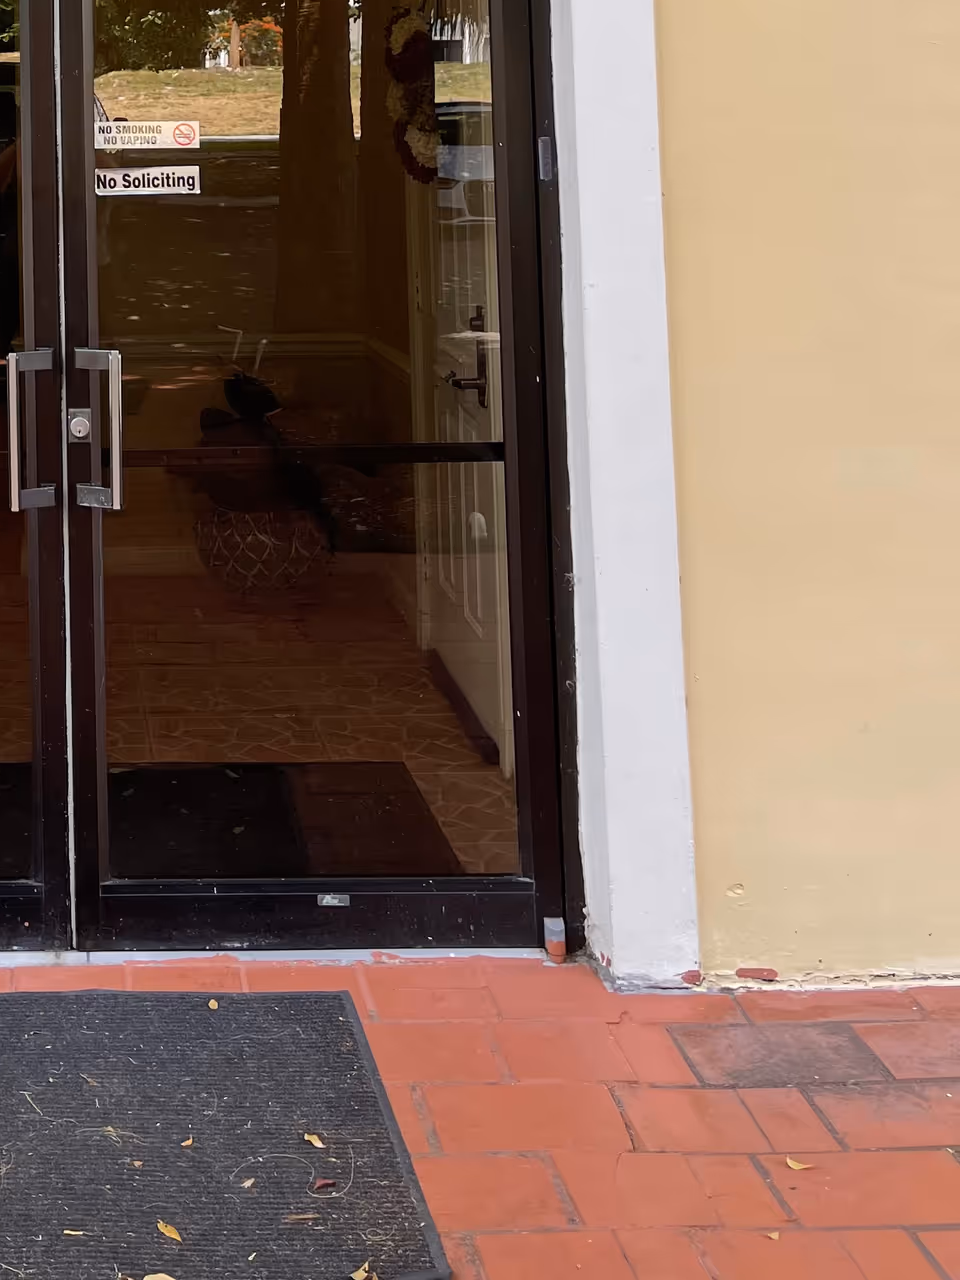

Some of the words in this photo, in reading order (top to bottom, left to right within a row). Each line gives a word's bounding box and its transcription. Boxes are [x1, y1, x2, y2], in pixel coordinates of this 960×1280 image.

[98, 125, 112, 134] NO
[115, 125, 162, 134] SMOKING
[104, 136, 117, 144] NO
[120, 136, 157, 144] VAPING
[97, 174, 117, 189] No
[122, 172, 195, 191] Soliciting
